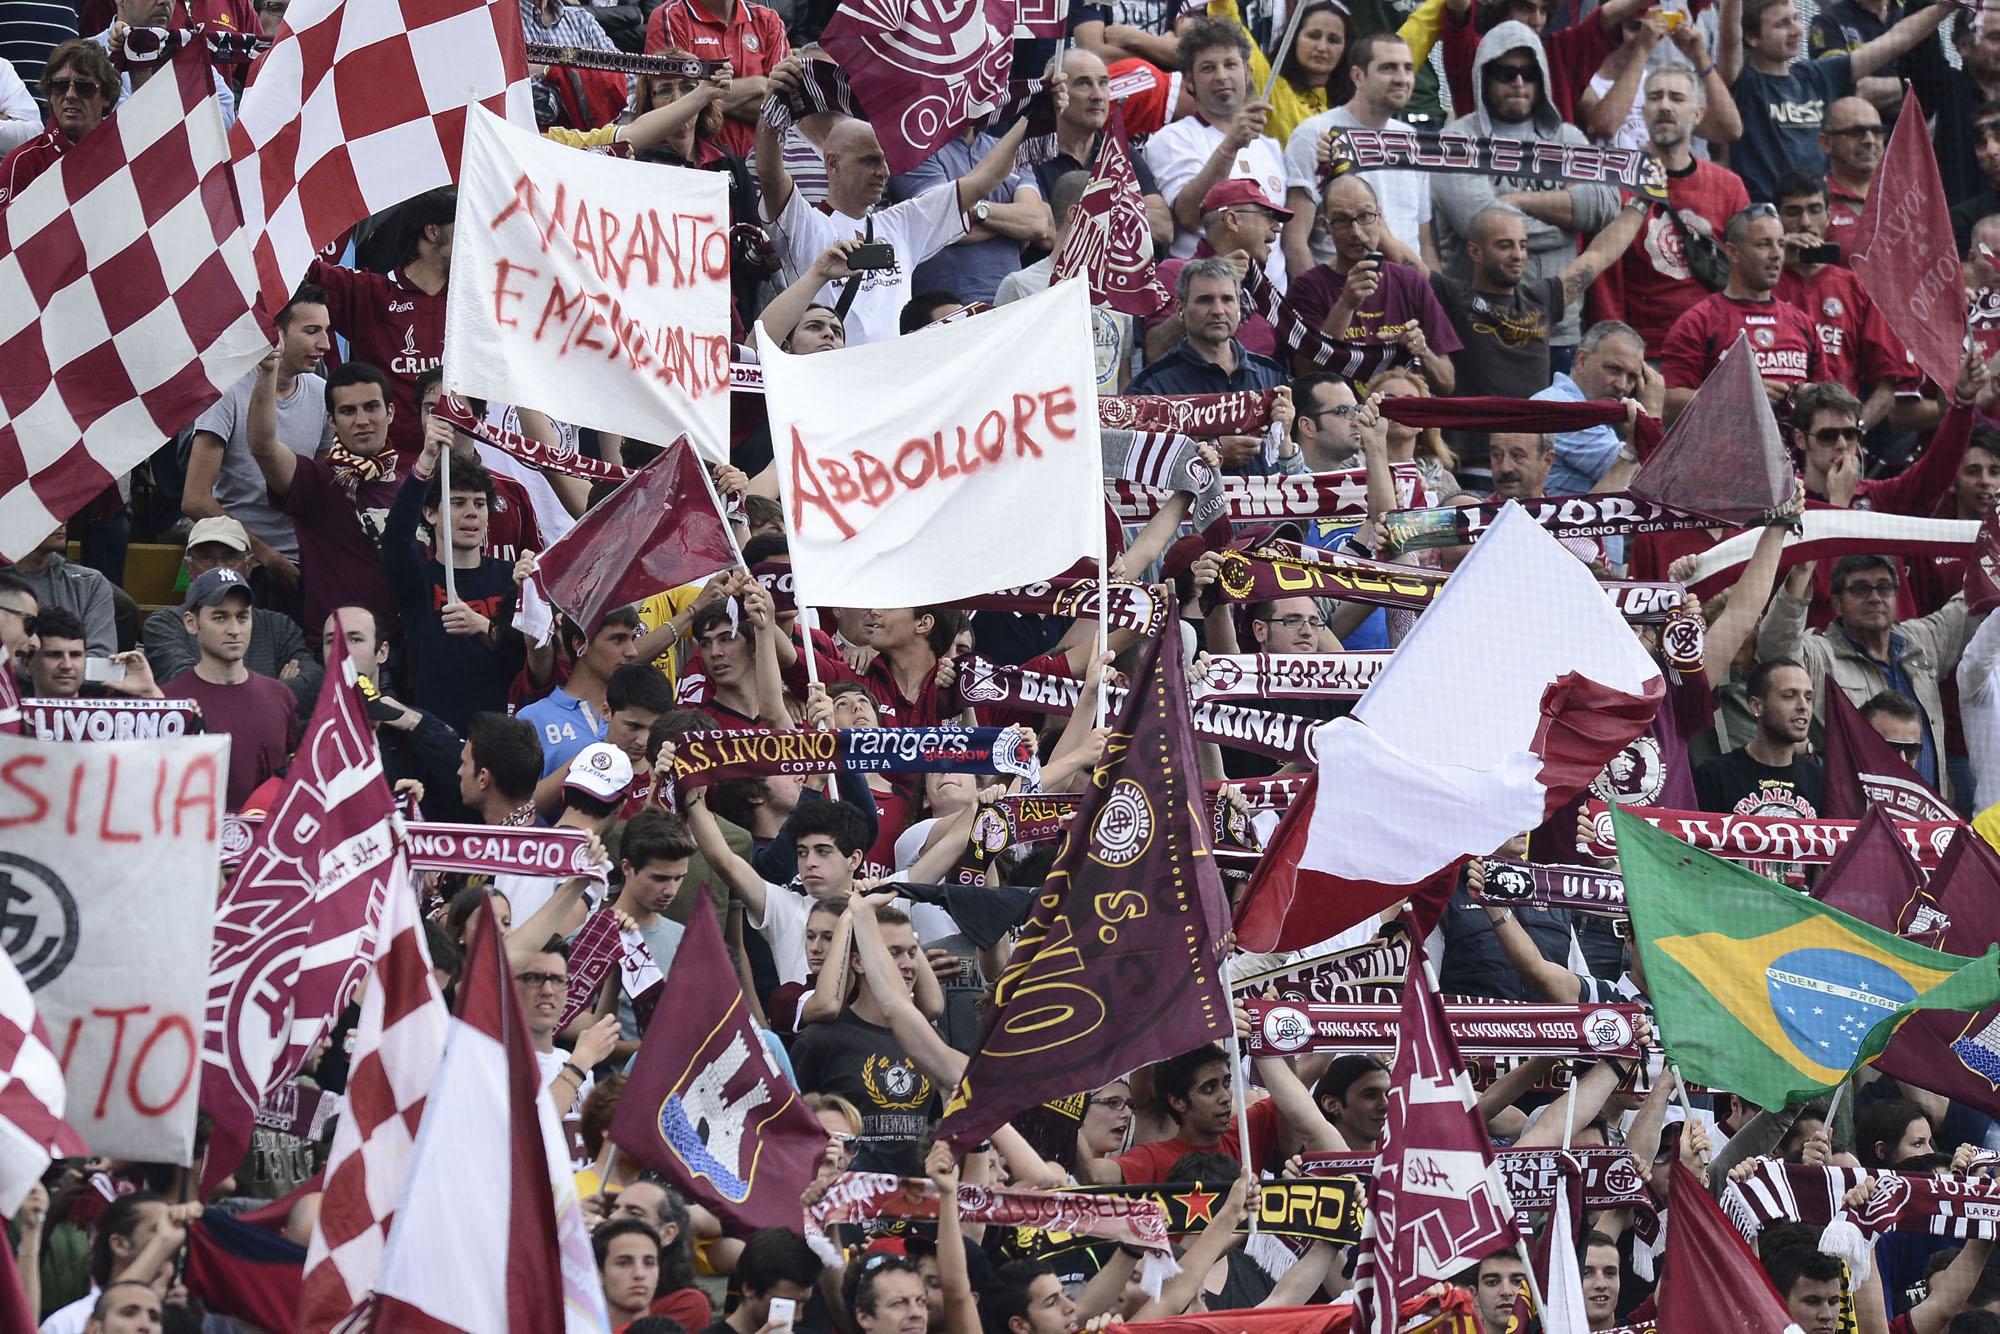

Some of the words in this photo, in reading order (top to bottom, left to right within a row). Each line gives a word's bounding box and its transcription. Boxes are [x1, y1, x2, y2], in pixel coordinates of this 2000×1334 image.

[1490, 136, 1523, 172] E
[1754, 350, 1808, 369] CARIGE
[1174, 390, 1246, 431] Protti
[1558, 524, 1616, 538] SOGNO
[1620, 521, 1634, 535] E'
[1637, 521, 1669, 533] GIA'
[757, 573, 793, 593] FO
[1275, 658, 1352, 690] FORZA
[34, 708, 186, 742] LIVORNO
[545, 722, 578, 745] 84
[683, 726, 770, 743] IVORNO
[1190, 701, 1303, 752] ARINAI
[673, 741, 717, 781] A.S.
[722, 732, 836, 768] LIVORNO
[850, 731, 969, 761] rangers
[780, 761, 837, 774] COPPA
[847, 759, 892, 771] UEFA
[1123, 783, 1151, 839] LIVORNO
[1761, 787, 1794, 805] ALL
[462, 836, 566, 870] CALCIO
[1099, 842, 1140, 863] CALCIO
[1562, 874, 1626, 904] ULTR
[1184, 924, 1206, 985] CALCIO
[1768, 969, 1818, 990] ORDEM
[1826, 984, 1835, 994] E
[1317, 1021, 1382, 1038] BRIGATE
[1462, 1021, 1537, 1039] LIVORNESI
[1537, 1022, 1579, 1040] 1999
[1255, 1184, 1346, 1231] ORD
